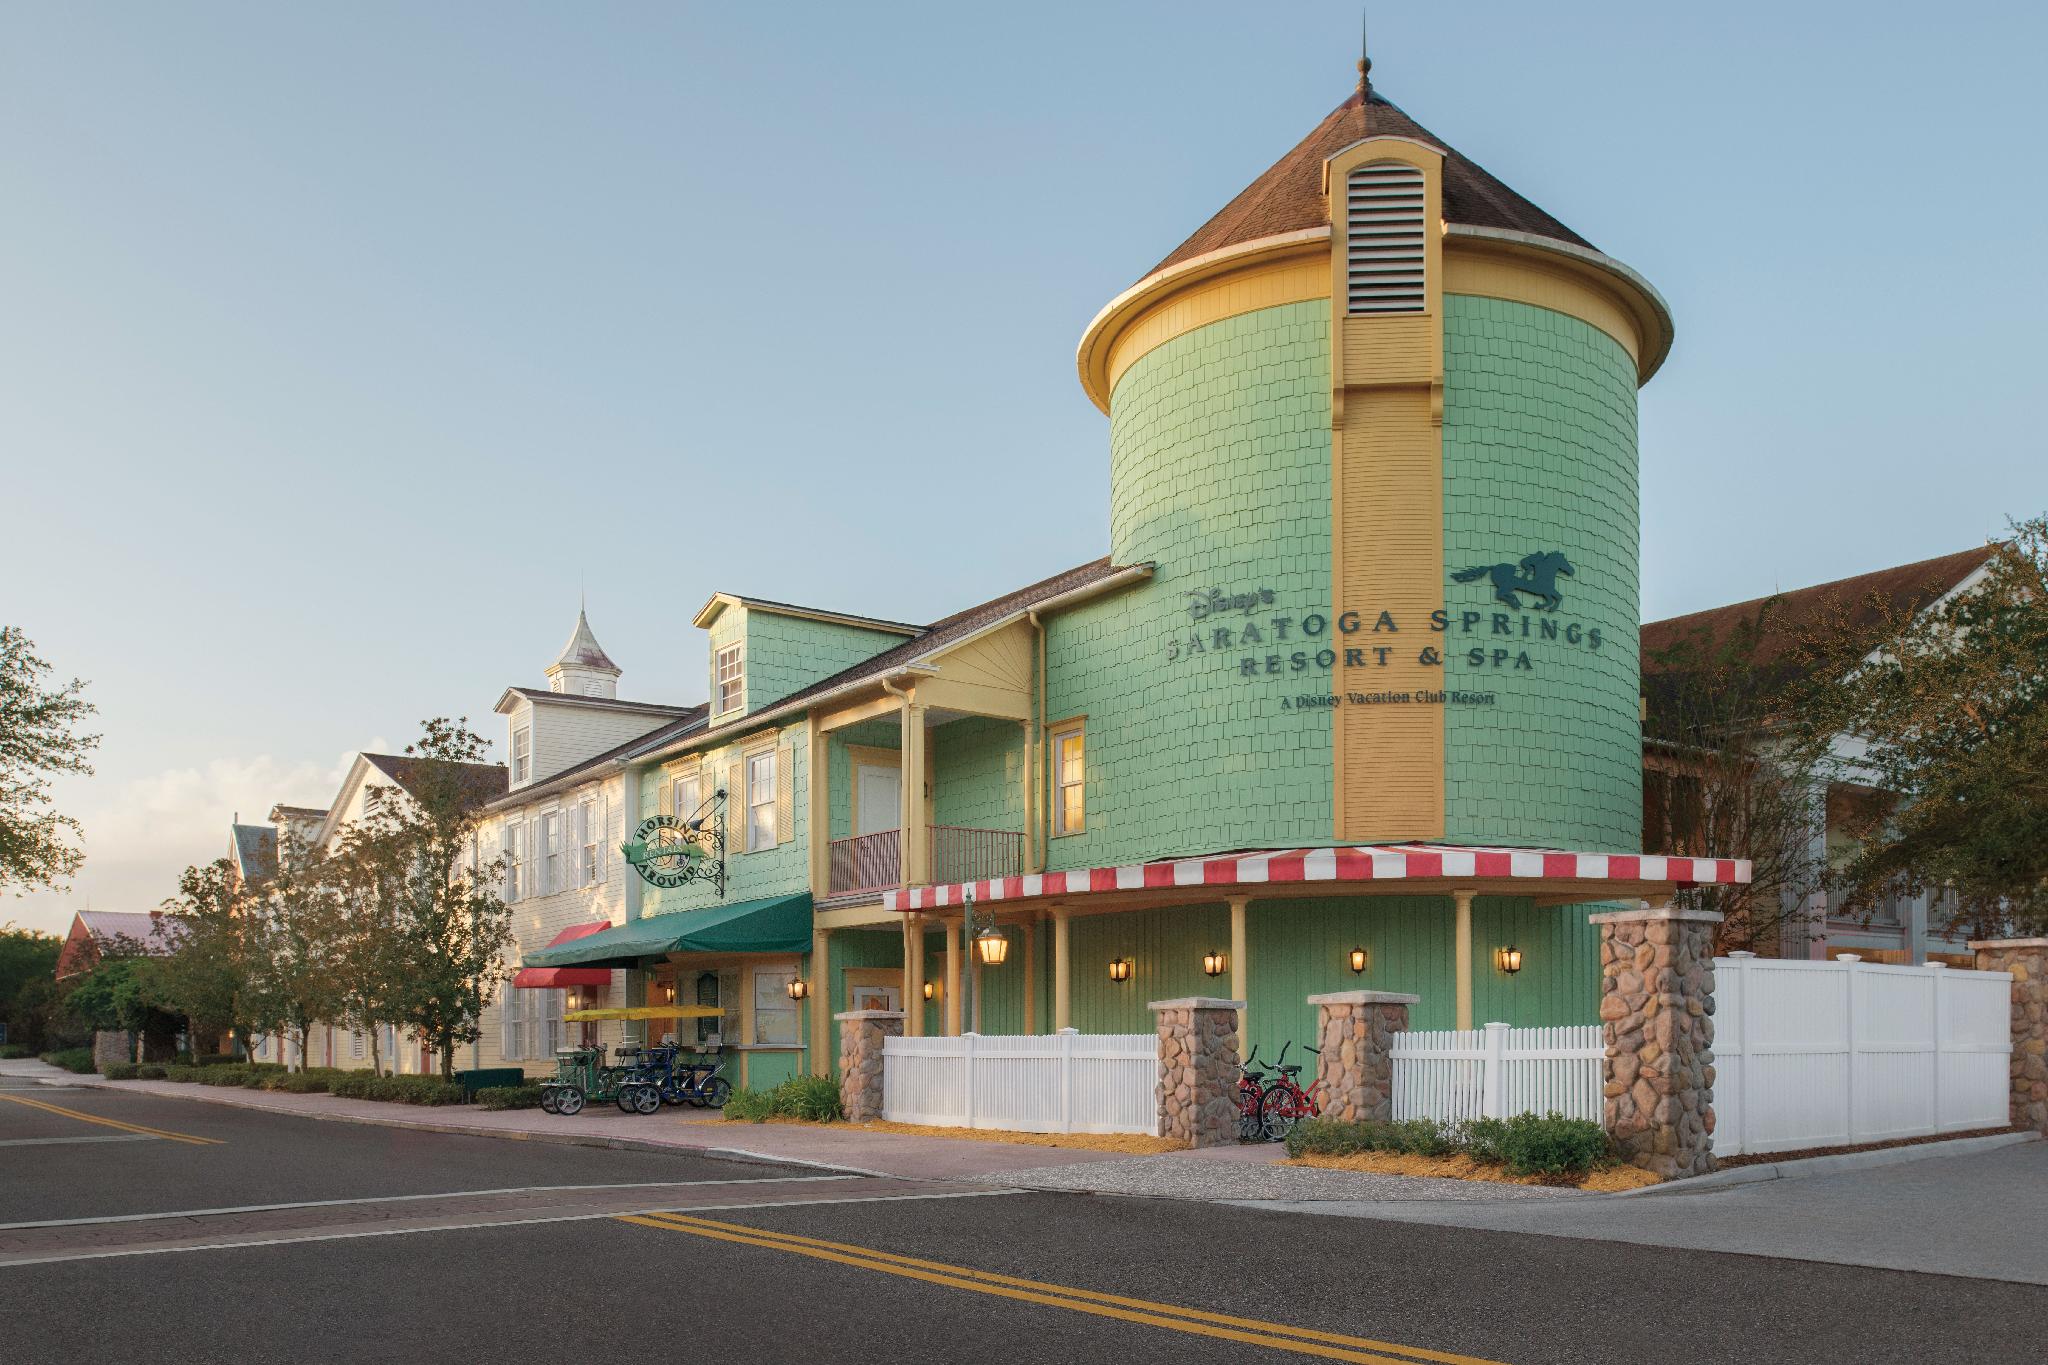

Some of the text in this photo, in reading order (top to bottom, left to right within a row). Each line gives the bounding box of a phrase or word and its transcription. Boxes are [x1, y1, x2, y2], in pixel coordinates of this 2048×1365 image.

[1183, 587, 1277, 620] Disney's
[1166, 609, 1602, 661] SARATOGA SPRINGS
[1240, 646, 1533, 677] RESORT & SPA
[1281, 689, 1496, 709] A Disney Vacation Club Resort
[636, 816, 698, 845] HORSING
[642, 846, 683, 860] RENTALS
[639, 864, 695, 887] AROUND
